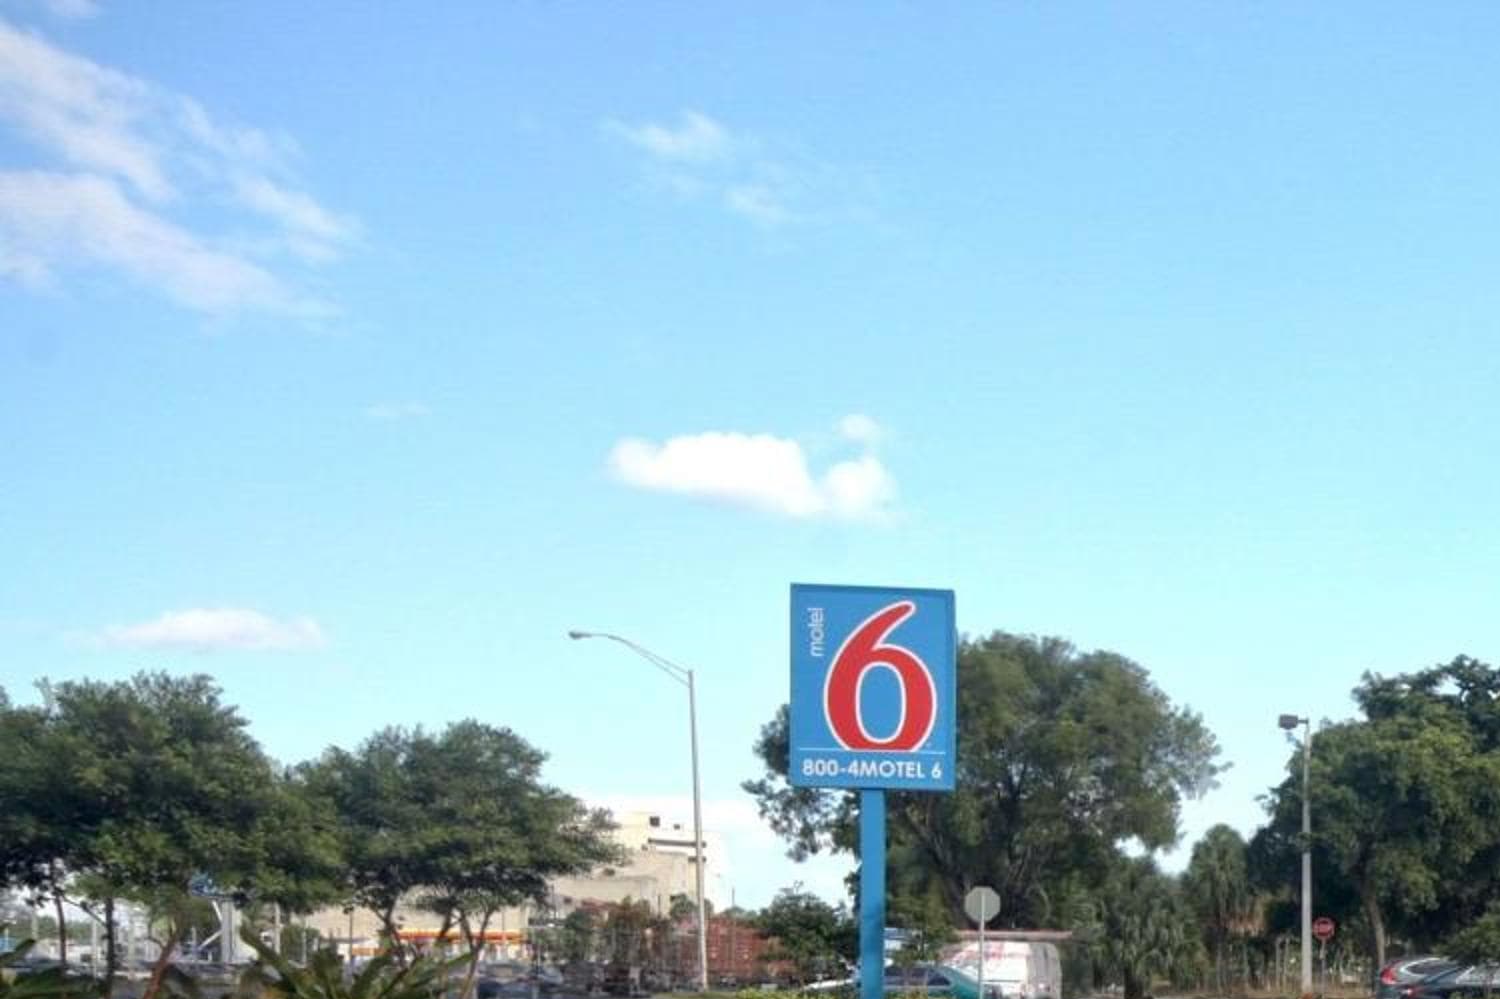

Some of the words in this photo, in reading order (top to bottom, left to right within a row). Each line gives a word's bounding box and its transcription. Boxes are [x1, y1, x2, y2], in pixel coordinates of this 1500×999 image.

[807, 608, 825, 657] motel
[823, 600, 937, 752] 6
[802, 758, 925, 779] 800-4MOTEL
[931, 762, 942, 779] 6
